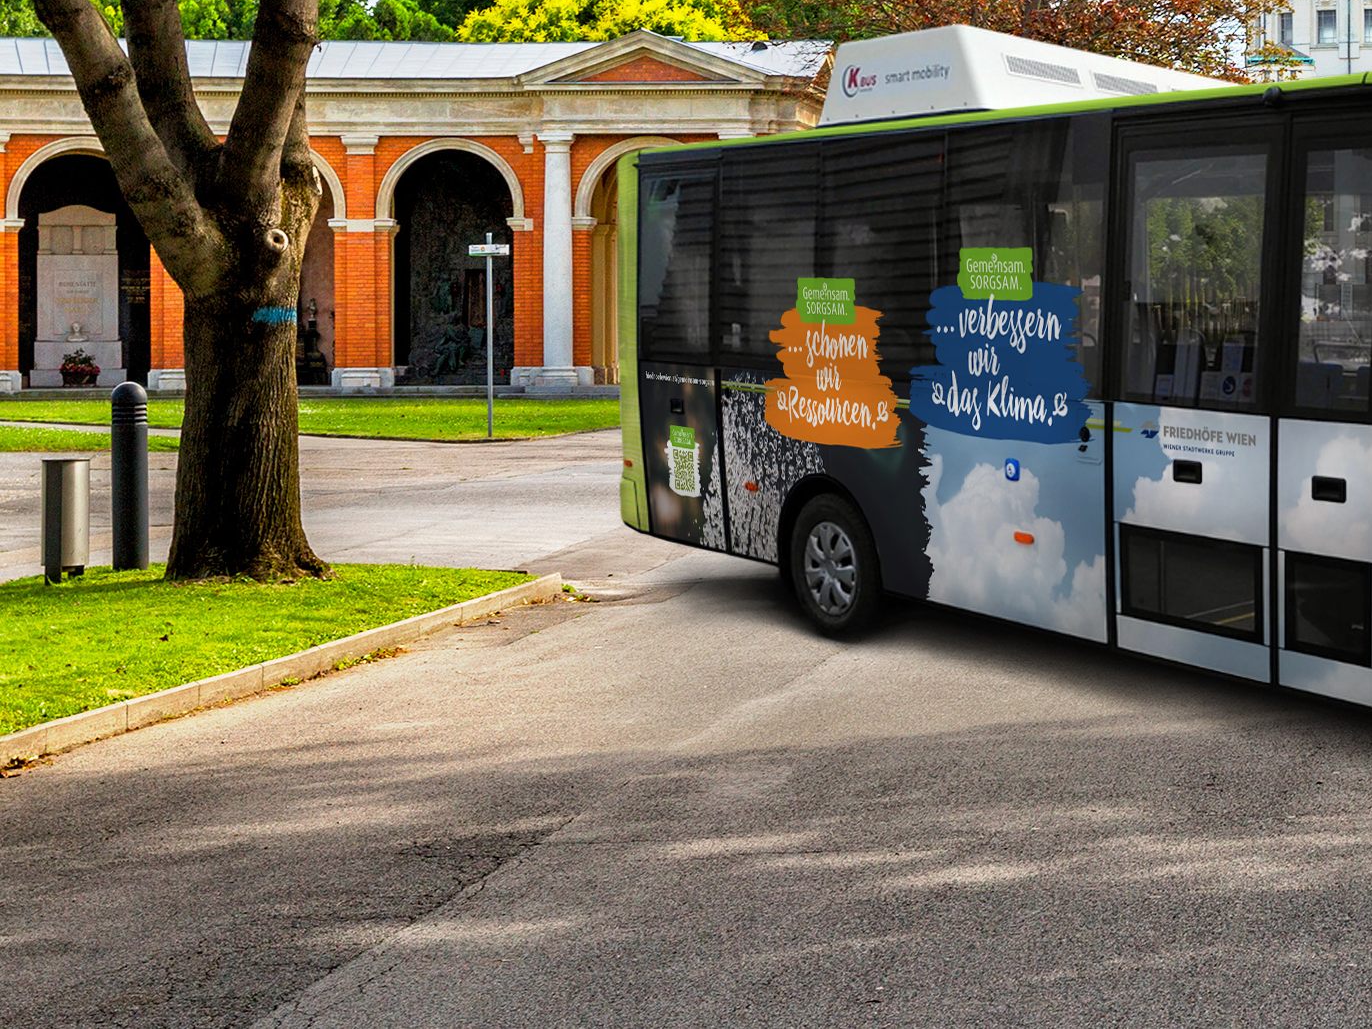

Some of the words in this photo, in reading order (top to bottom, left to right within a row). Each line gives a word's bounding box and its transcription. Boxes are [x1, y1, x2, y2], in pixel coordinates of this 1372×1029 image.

[884, 70, 910, 84] smart
[912, 65, 950, 80] mobility
[966, 253, 1026, 274] Gemeinsam.
[802, 282, 850, 302] Gemeinsam.
[970, 275, 1023, 291] SORGSAM.
[806, 301, 848, 316] SORGSAM.
[968, 343, 1000, 377] wir
[816, 363, 842, 392] wir
[788, 386, 877, 431] Ressourcen.
[946, 370, 982, 431] das
[986, 375, 1053, 427] Klima.
[1163, 425, 1223, 443] FRIEDHÖFE
[1226, 431, 1256, 446] WIEN
